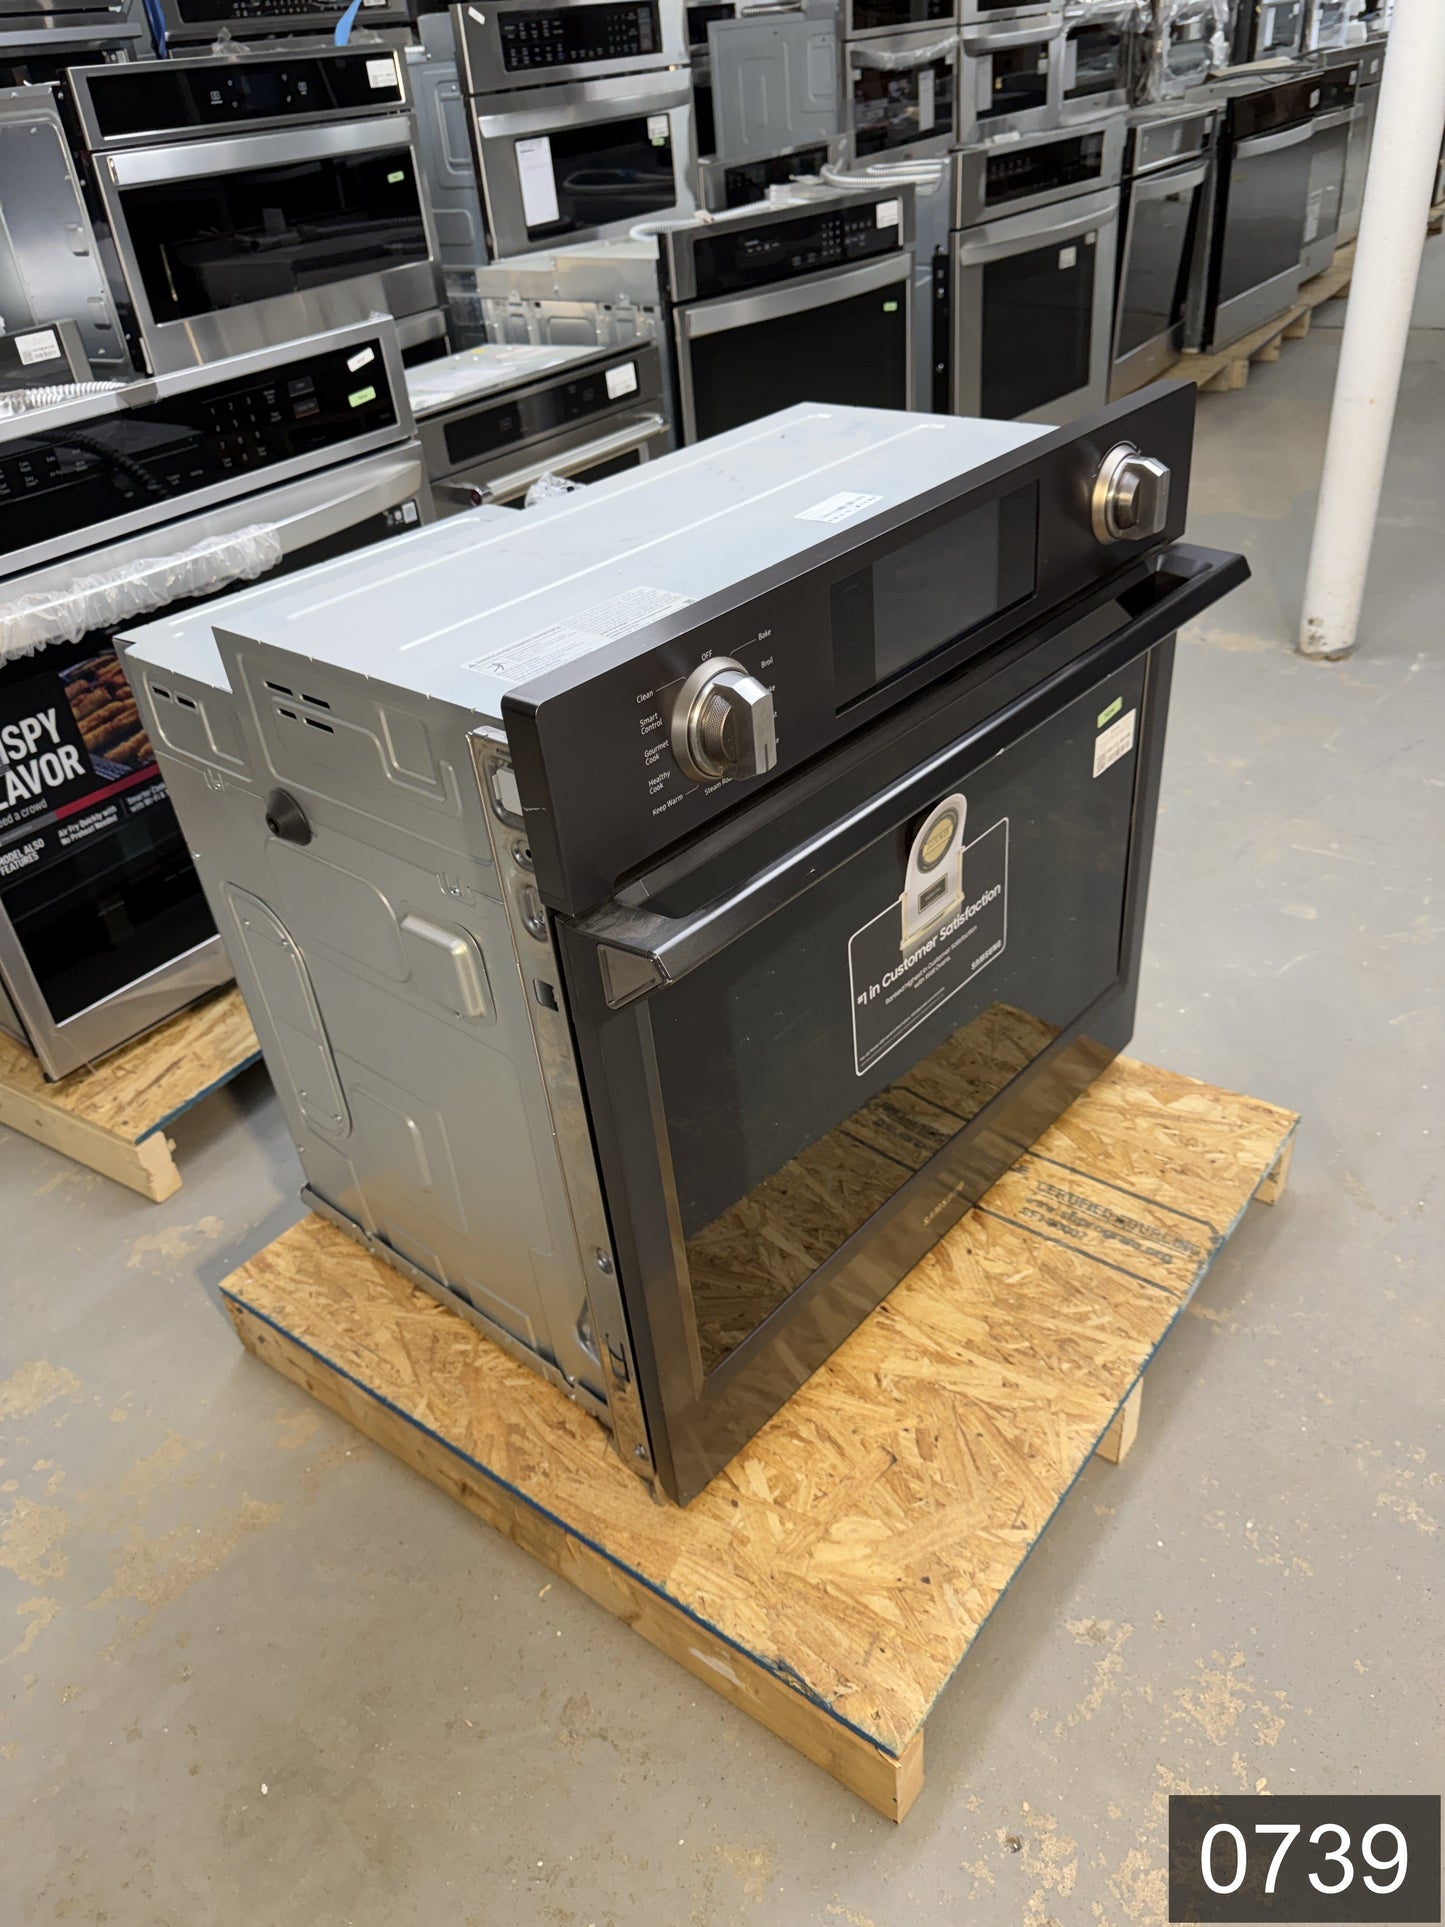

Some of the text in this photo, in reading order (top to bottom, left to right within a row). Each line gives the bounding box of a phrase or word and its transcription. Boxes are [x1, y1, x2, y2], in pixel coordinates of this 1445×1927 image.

[758, 629, 772, 640] Bake
[702, 649, 712, 661] OFF
[761, 656, 774, 668] Broil
[636, 690, 654, 704] Clean
[640, 712, 658, 728] Smart
[641, 718, 662, 735] Control
[644, 740, 669, 758] Gourmet
[645, 754, 660, 766] Cook
[0, 744, 86, 810] AVOR
[648, 770, 670, 788] Healthy
[650, 782, 664, 794] Cook
[704, 782, 721, 796] Steam
[14, 812, 20, 822] a
[20, 798, 48, 818] crowd
[652, 794, 684, 816] Keep Warm
[68, 824, 80, 834] Fry
[22, 838, 46, 856] ALSO
[0, 852, 40, 876] FEATURES
[857, 992, 867, 1006] #1
[868, 983, 880, 1000] in
[882, 936, 938, 988] Customer
[940, 884, 1001, 942] Satisfaction
[971, 940, 1002, 970] SAMSUNG
